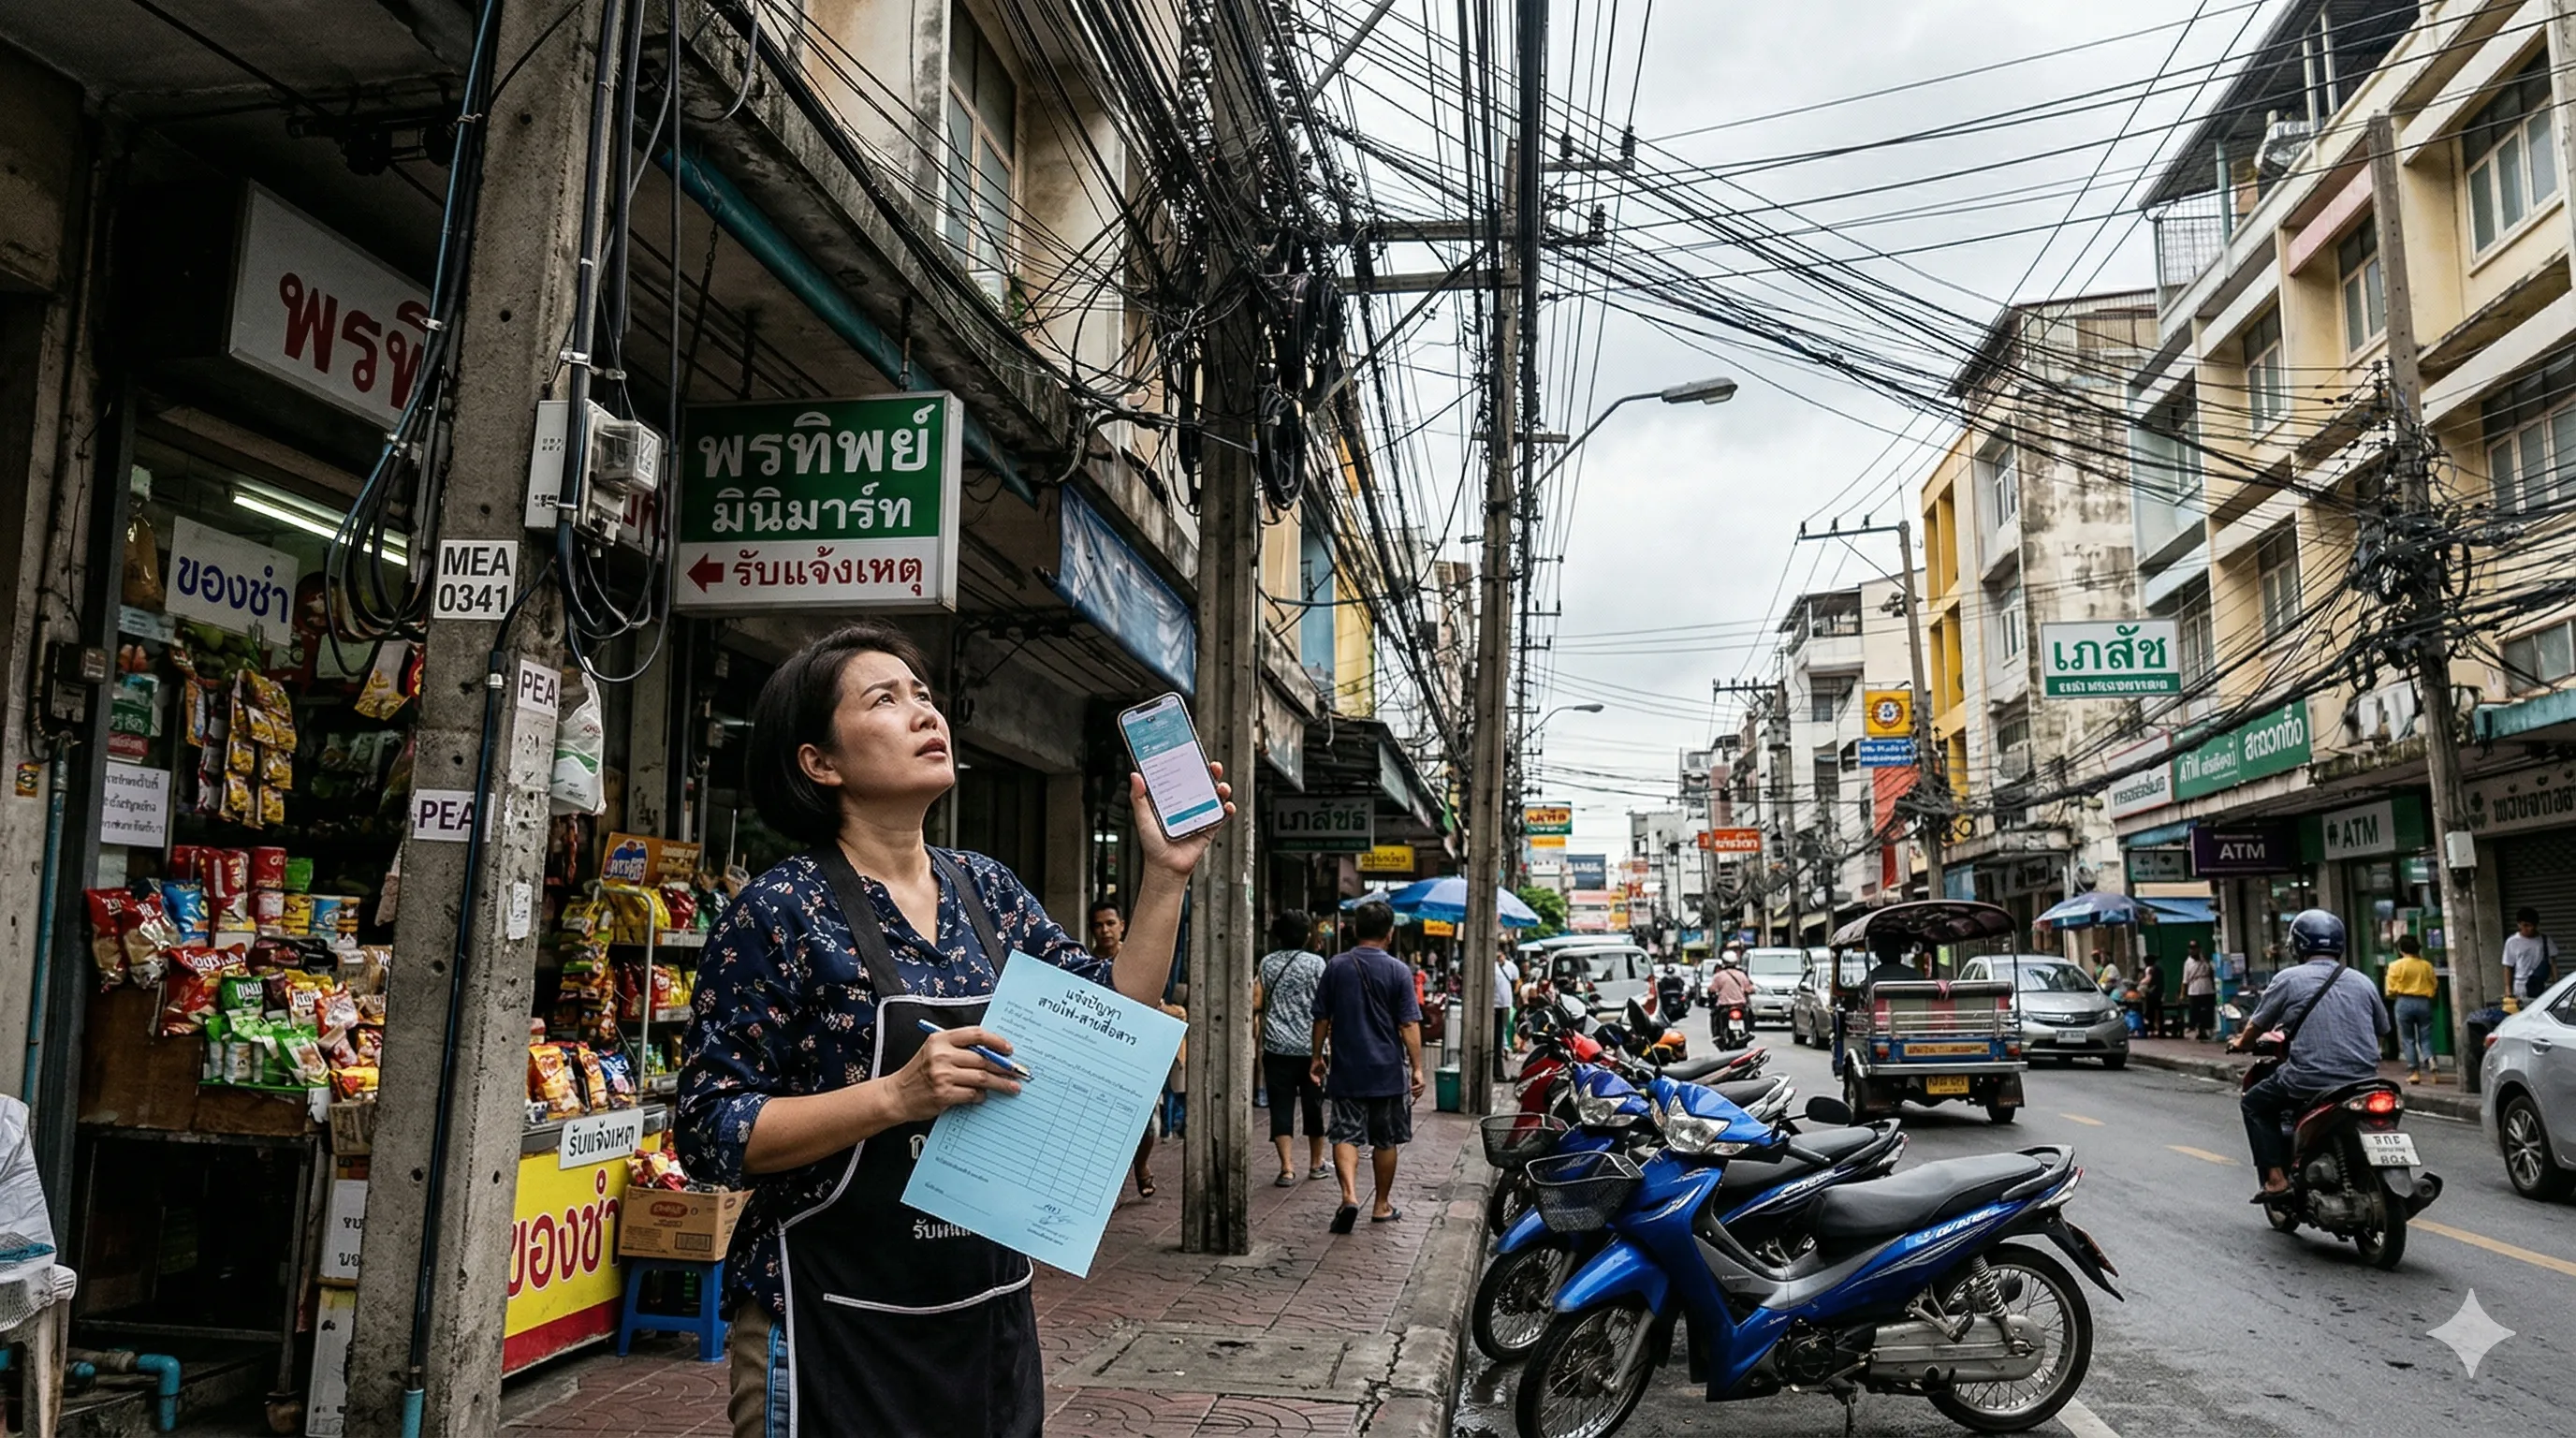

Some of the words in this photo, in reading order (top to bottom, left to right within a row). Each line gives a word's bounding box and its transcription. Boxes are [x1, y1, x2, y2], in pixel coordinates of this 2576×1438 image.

[698, 404, 936, 477] พรทิพย์
[712, 481, 912, 533] มินิมาร์ท
[443, 547, 511, 577] MEA
[733, 546, 923, 596] รับแจ้งเหตุ
[177, 556, 288, 624] ของชำ
[438, 583, 508, 612] 0341
[2054, 624, 2167, 671] เภสัช
[520, 669, 557, 708] PEA
[418, 800, 476, 831] PEA
[2342, 814, 2379, 849] ATM
[2219, 843, 2266, 860] ATM
[568, 1120, 636, 1157] รับแจ้งเหตุ
